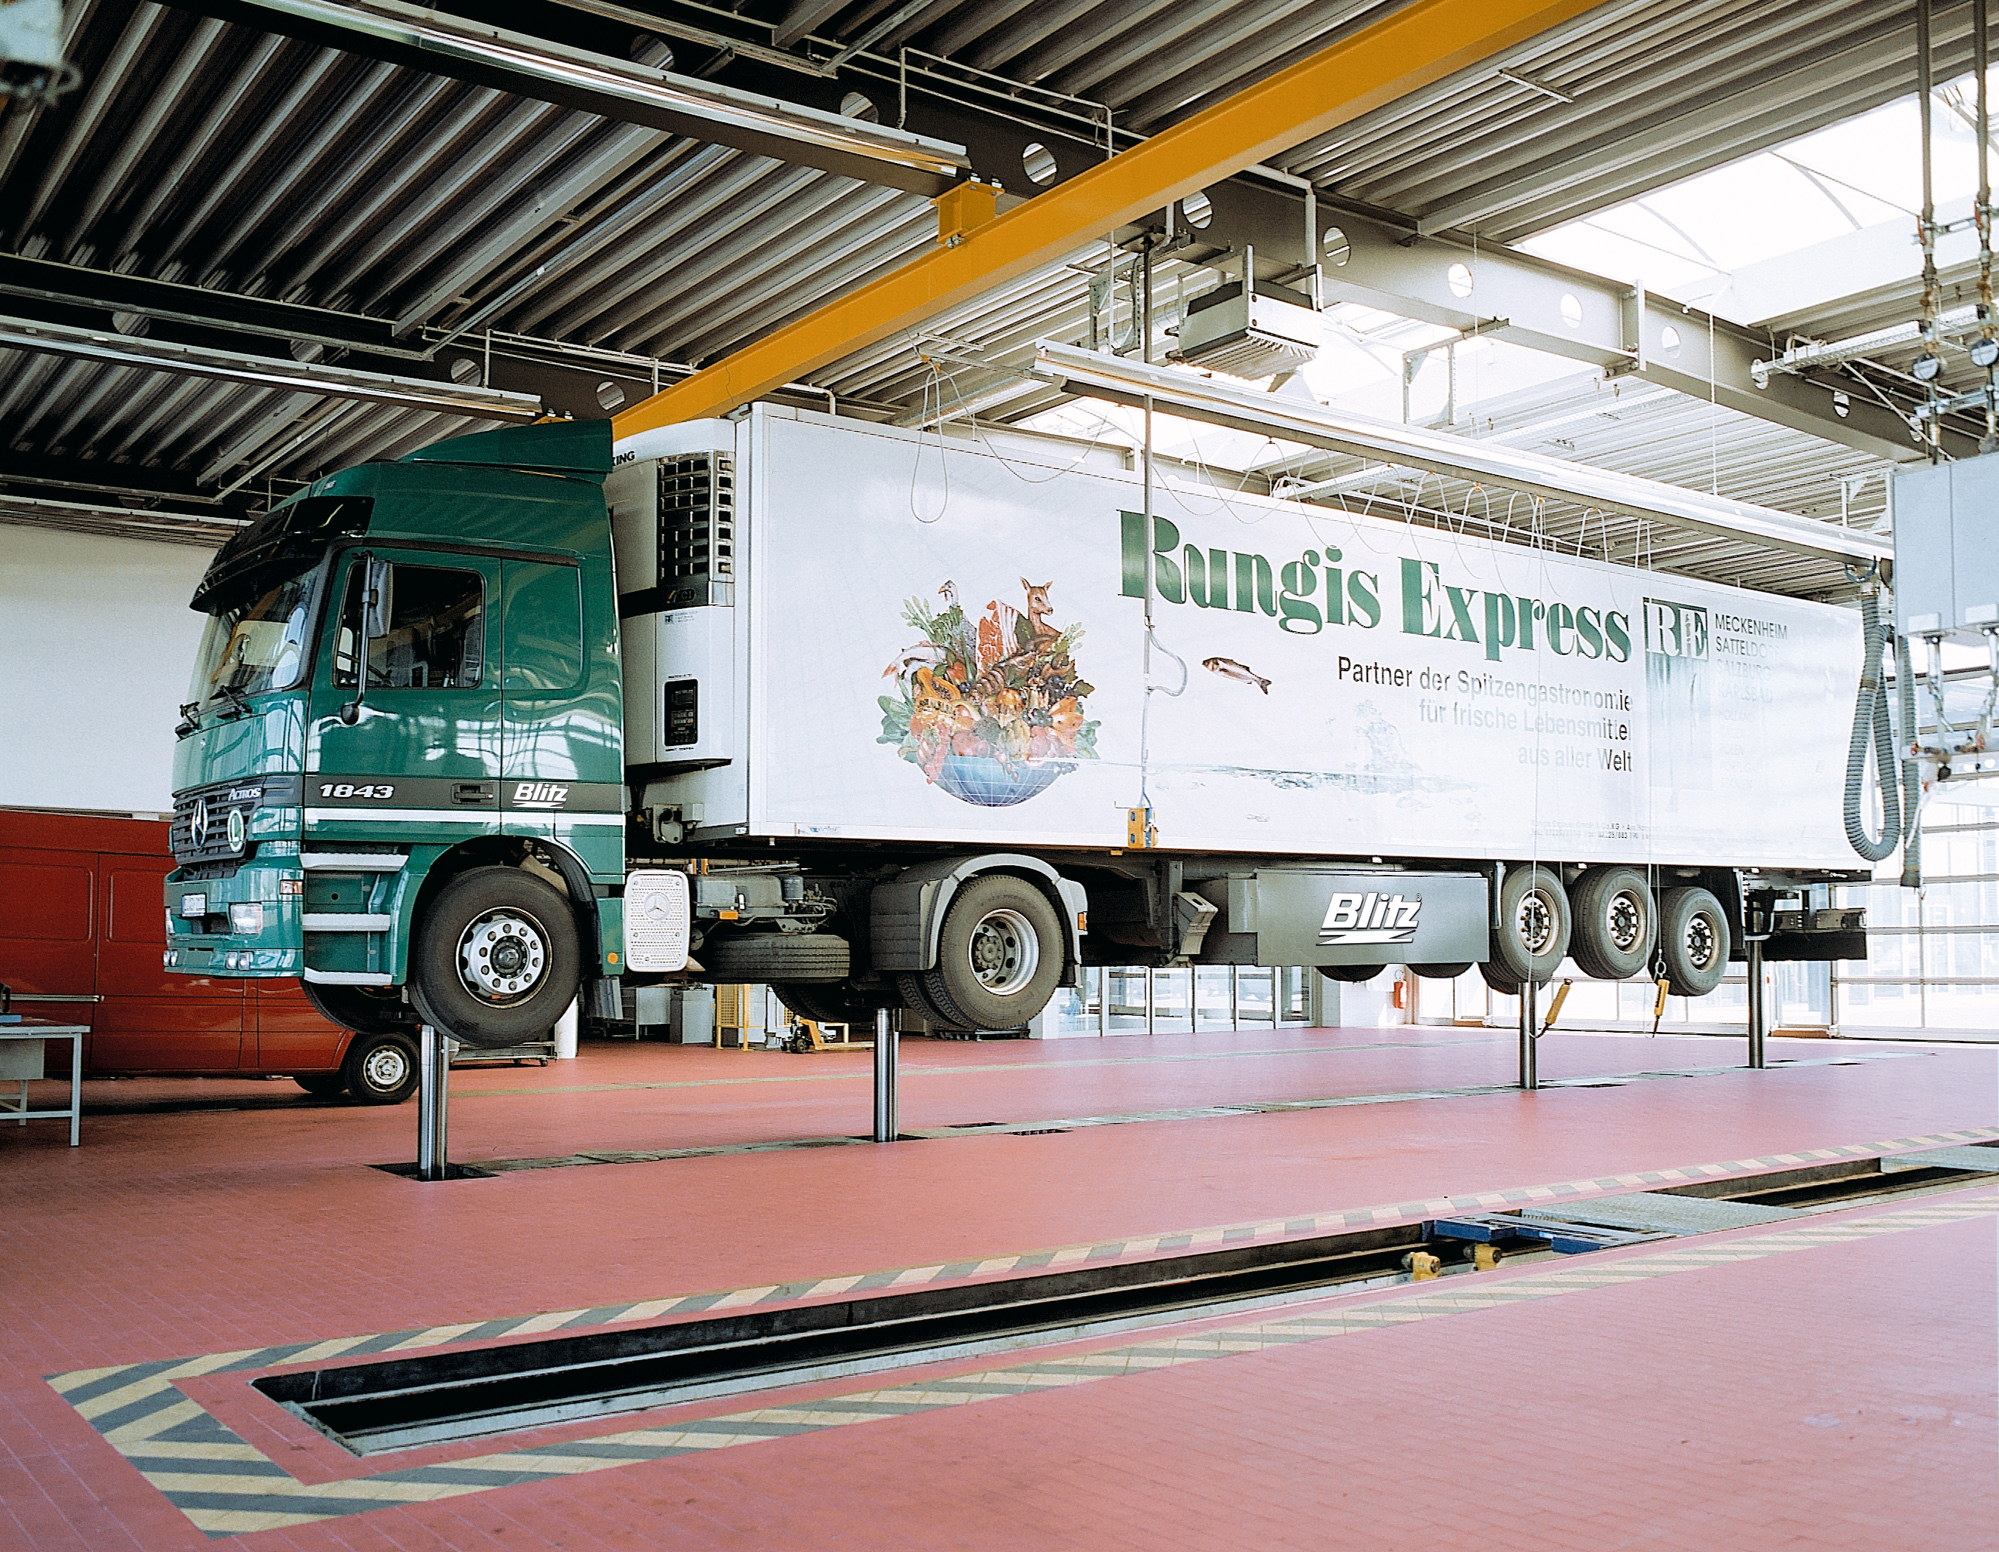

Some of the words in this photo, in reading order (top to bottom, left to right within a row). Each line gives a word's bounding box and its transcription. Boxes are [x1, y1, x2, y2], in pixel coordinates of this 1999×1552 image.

[1117, 510, 1381, 634] Rungis
[1398, 557, 1632, 662] Express
[1715, 613, 1788, 640] MECKENHEIM
[1716, 658, 1772, 682] SALZBURG
[1337, 656, 1413, 688] Partner
[1419, 666, 1452, 692] der
[1457, 670, 1634, 712] Spitzengastronomie
[1419, 698, 1446, 724] für
[1453, 702, 1518, 730] frische
[1524, 708, 1632, 742] Lebensmittel
[1518, 745, 1549, 766] aus
[1555, 746, 1592, 769] aller
[1597, 748, 1633, 772] Welt
[319, 783, 394, 799] 1843
[232, 818, 239, 842] L
